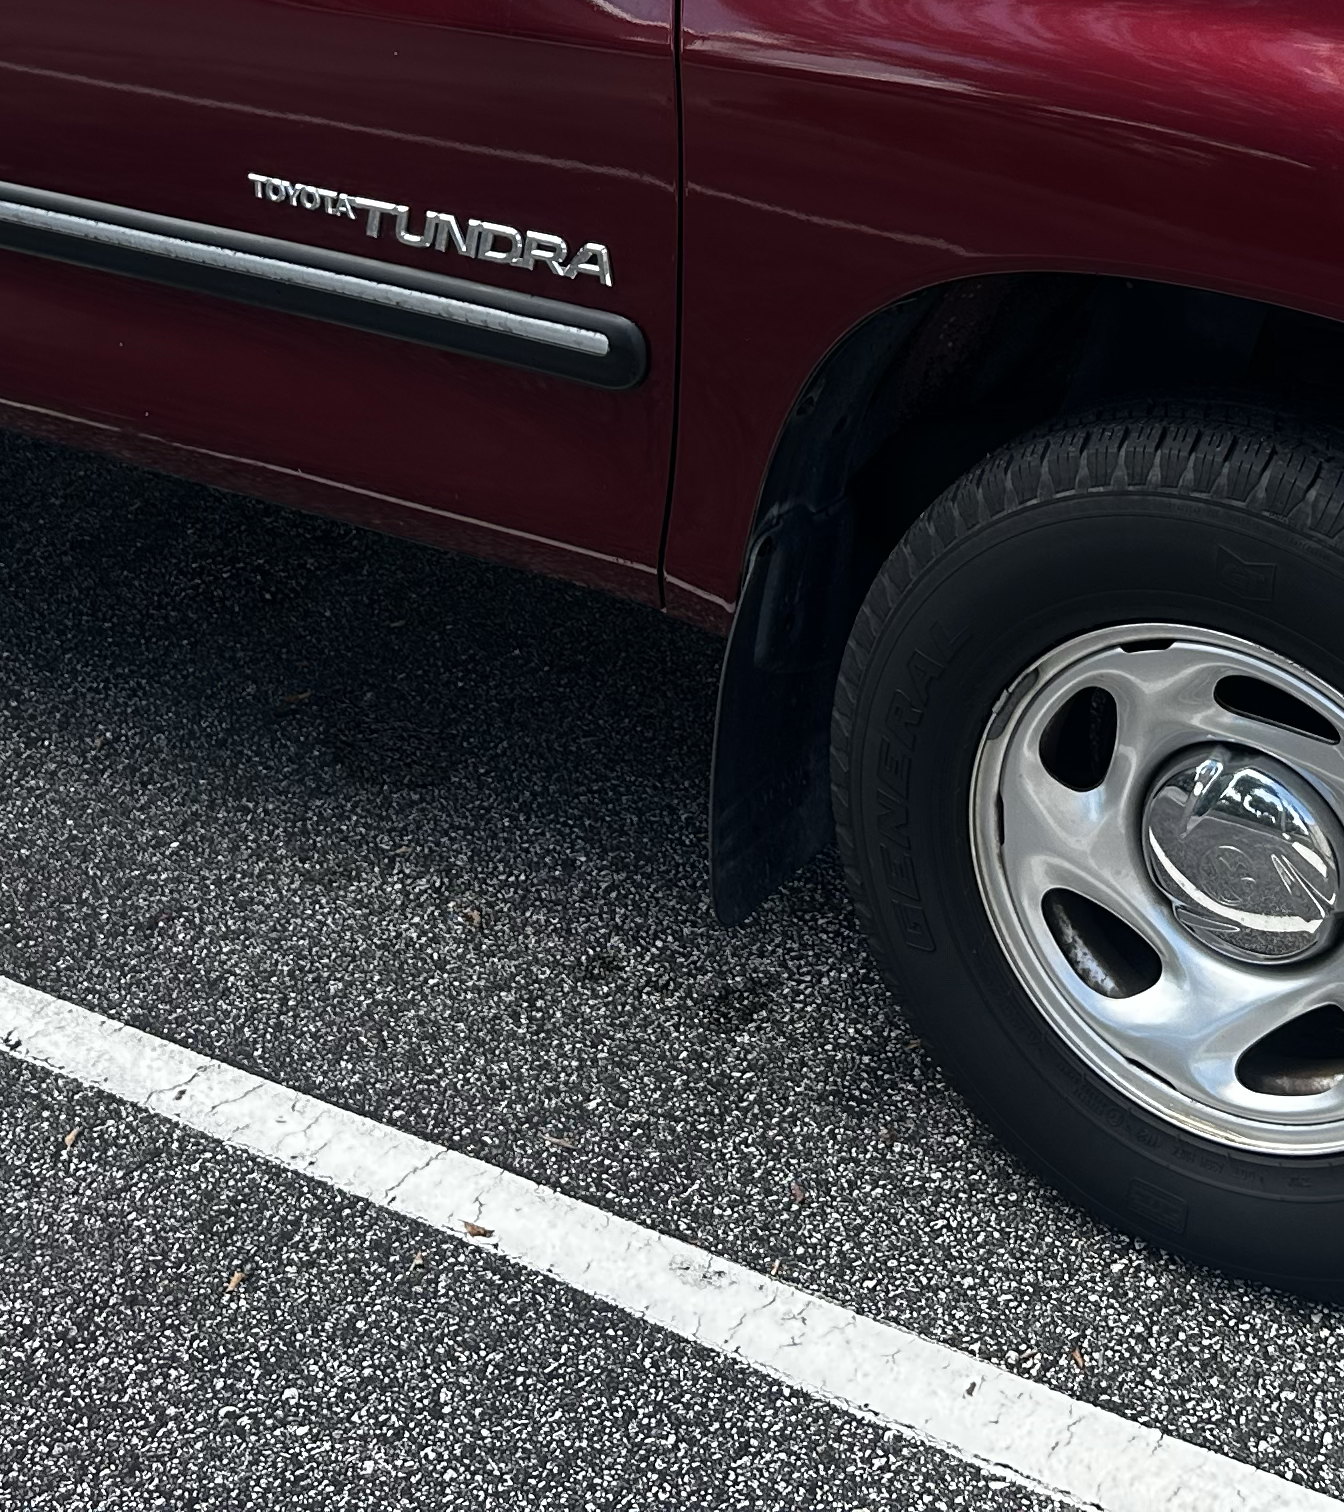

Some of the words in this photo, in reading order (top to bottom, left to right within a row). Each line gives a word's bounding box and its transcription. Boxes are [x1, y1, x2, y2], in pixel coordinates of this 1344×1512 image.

[248, 172, 357, 220] TOYOTA
[355, 196, 613, 288] TUNDRA
[876, 620, 973, 953] GENERAL
